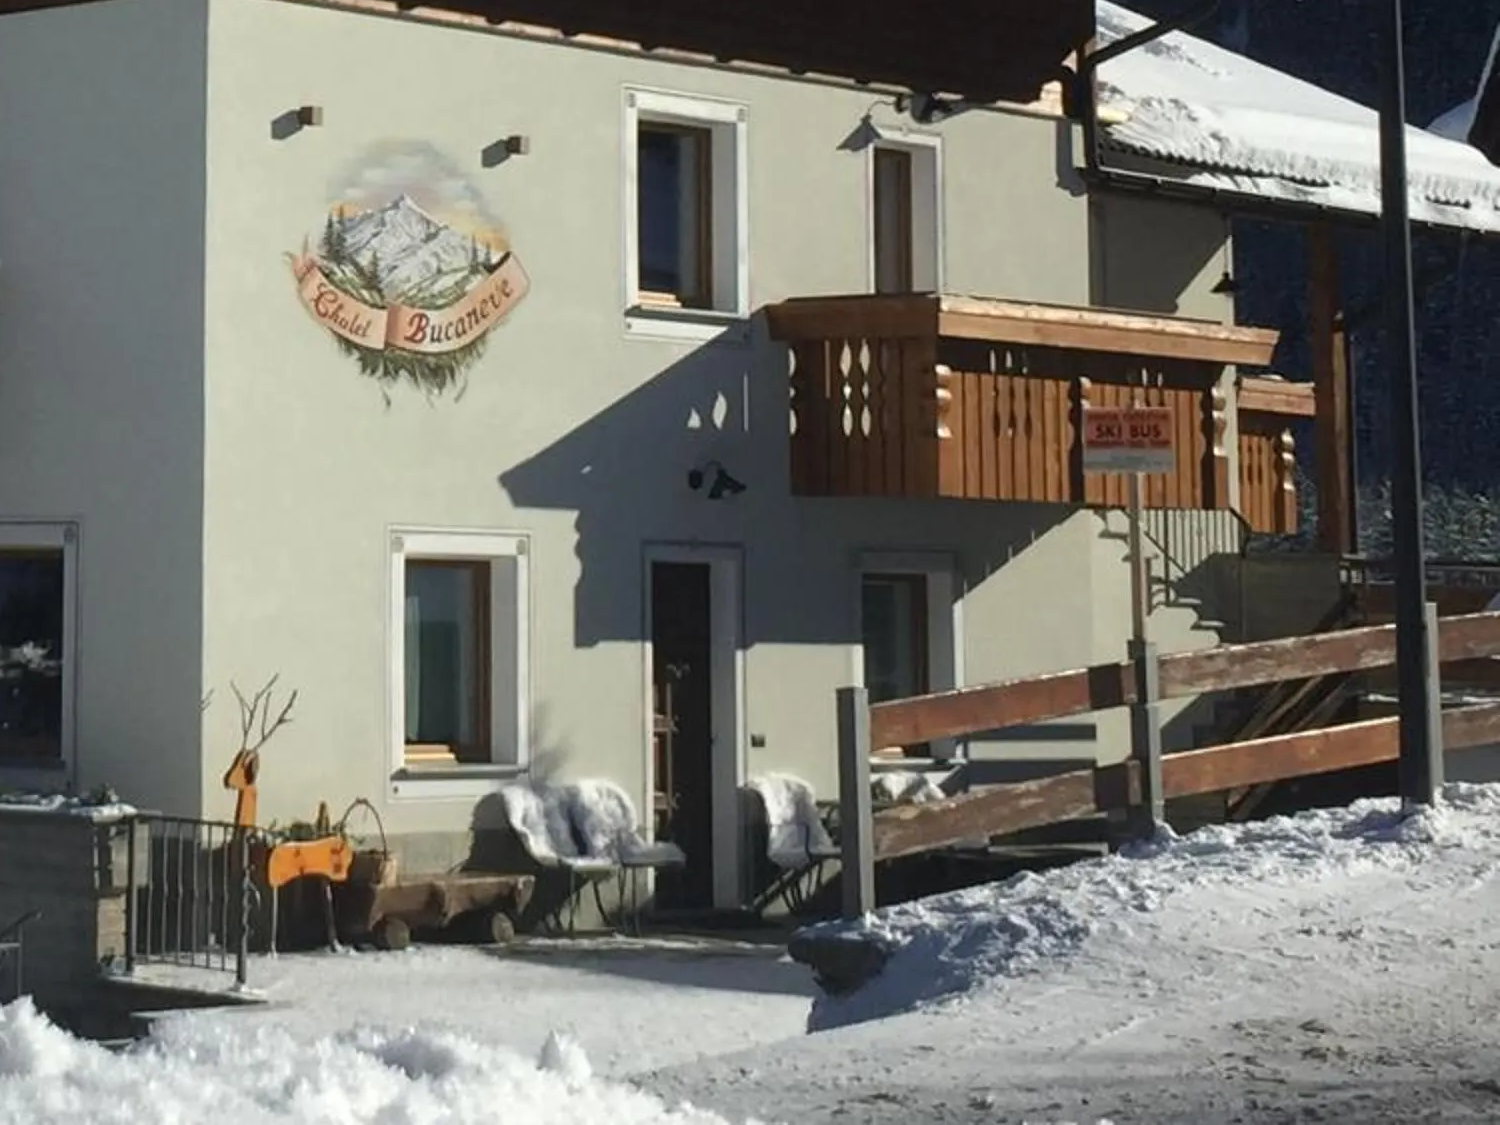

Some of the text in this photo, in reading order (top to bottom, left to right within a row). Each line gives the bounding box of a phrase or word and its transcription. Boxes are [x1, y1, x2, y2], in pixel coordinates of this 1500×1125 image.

[312, 277, 514, 344] Chalet Bucaneve
[1095, 423, 1161, 438] SKI BUS
